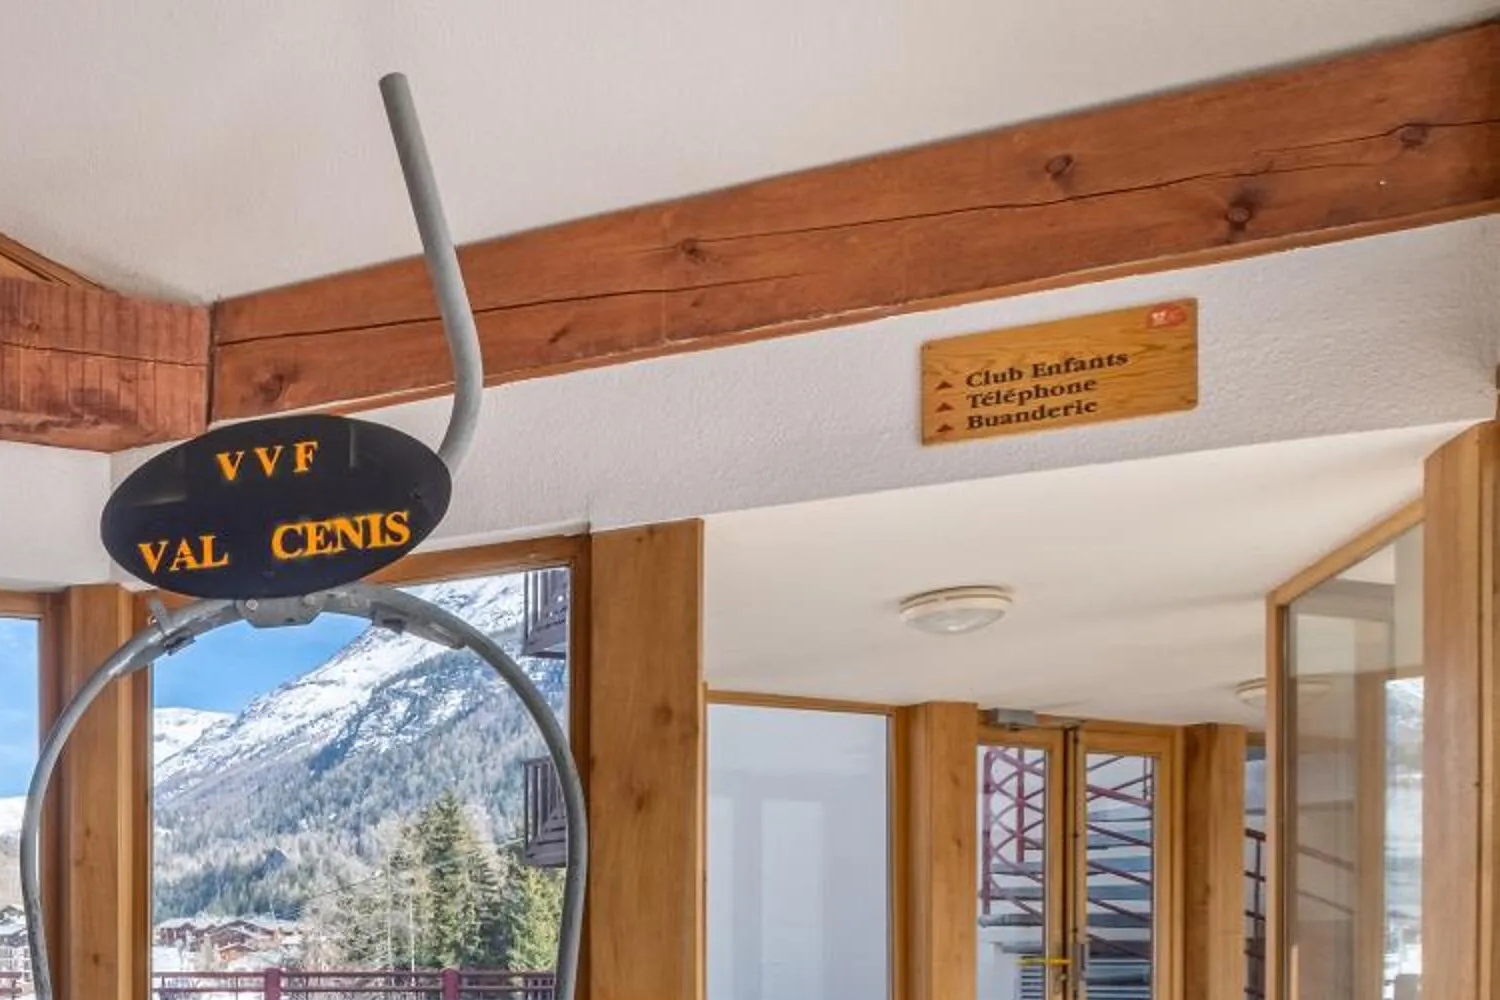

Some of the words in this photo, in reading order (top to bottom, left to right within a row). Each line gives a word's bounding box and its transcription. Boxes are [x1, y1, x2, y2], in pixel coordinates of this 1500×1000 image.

[965, 366, 1024, 388] Club
[1031, 351, 1129, 379] Enfants
[966, 378, 1098, 410] Téléphone
[966, 399, 1098, 431] Buanderie
[138, 534, 230, 575] VAL
[270, 510, 412, 561] CENIS
